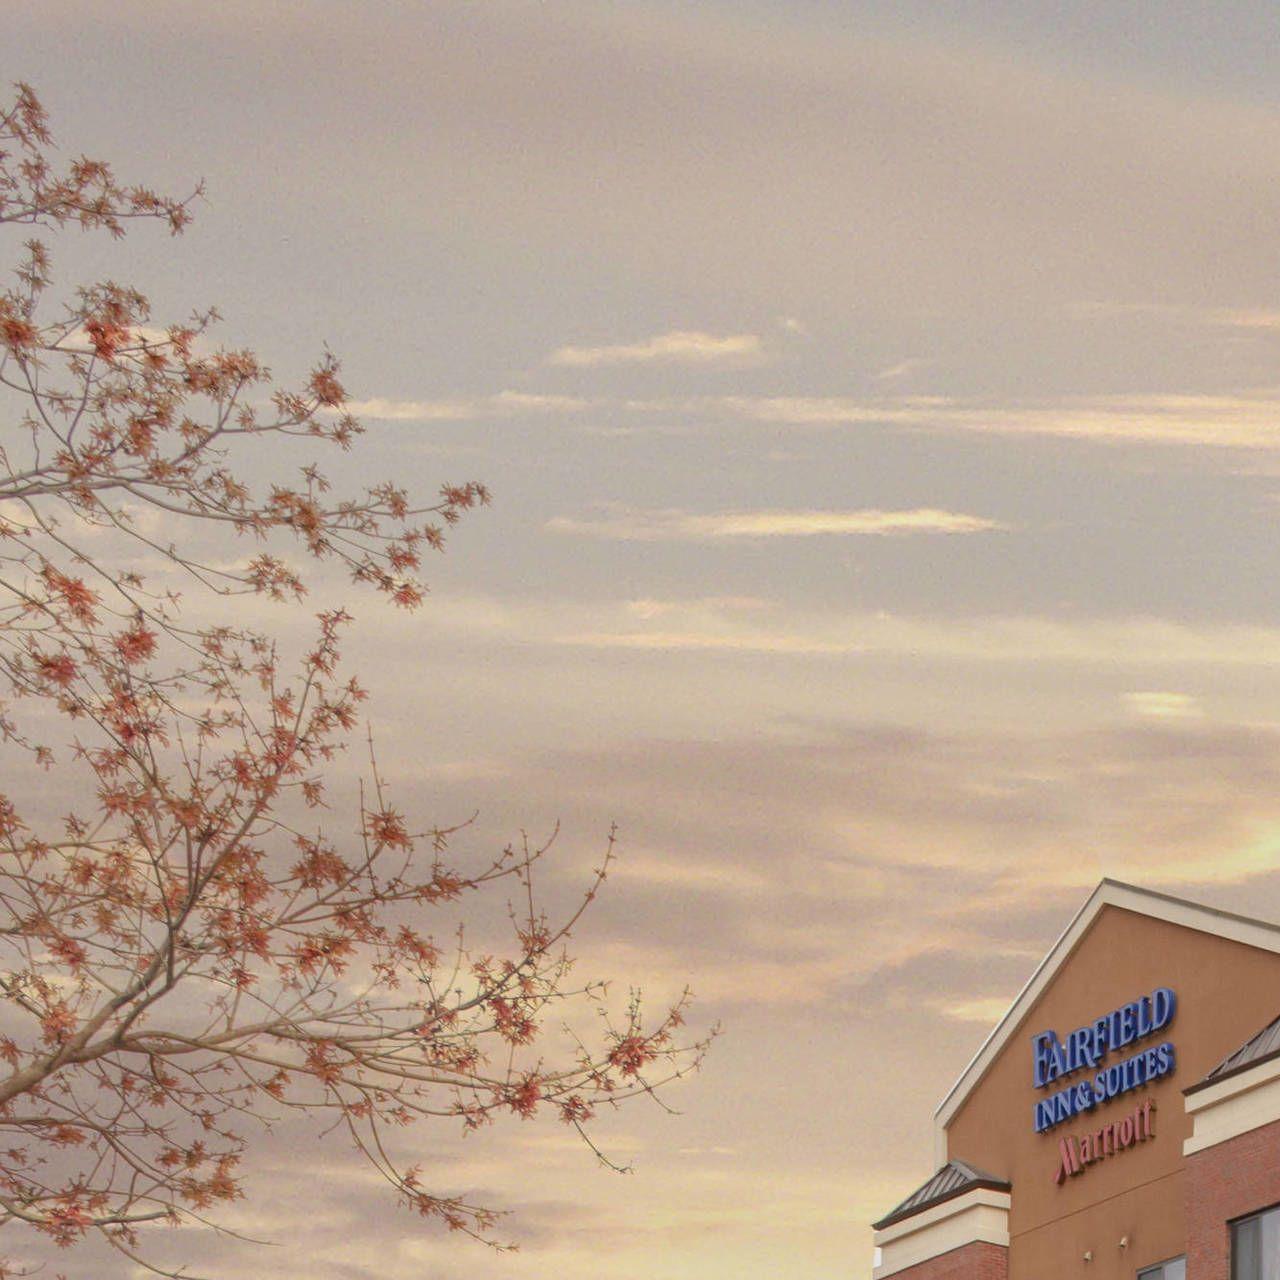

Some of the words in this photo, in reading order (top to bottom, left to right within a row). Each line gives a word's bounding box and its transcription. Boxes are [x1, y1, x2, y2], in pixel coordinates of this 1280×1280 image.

[1032, 987, 1176, 1089] FAIRFIELD
[1032, 1085, 1077, 1133] INN
[1093, 1042, 1176, 1103] SUITES
[1055, 1097, 1156, 1185] Marriott
